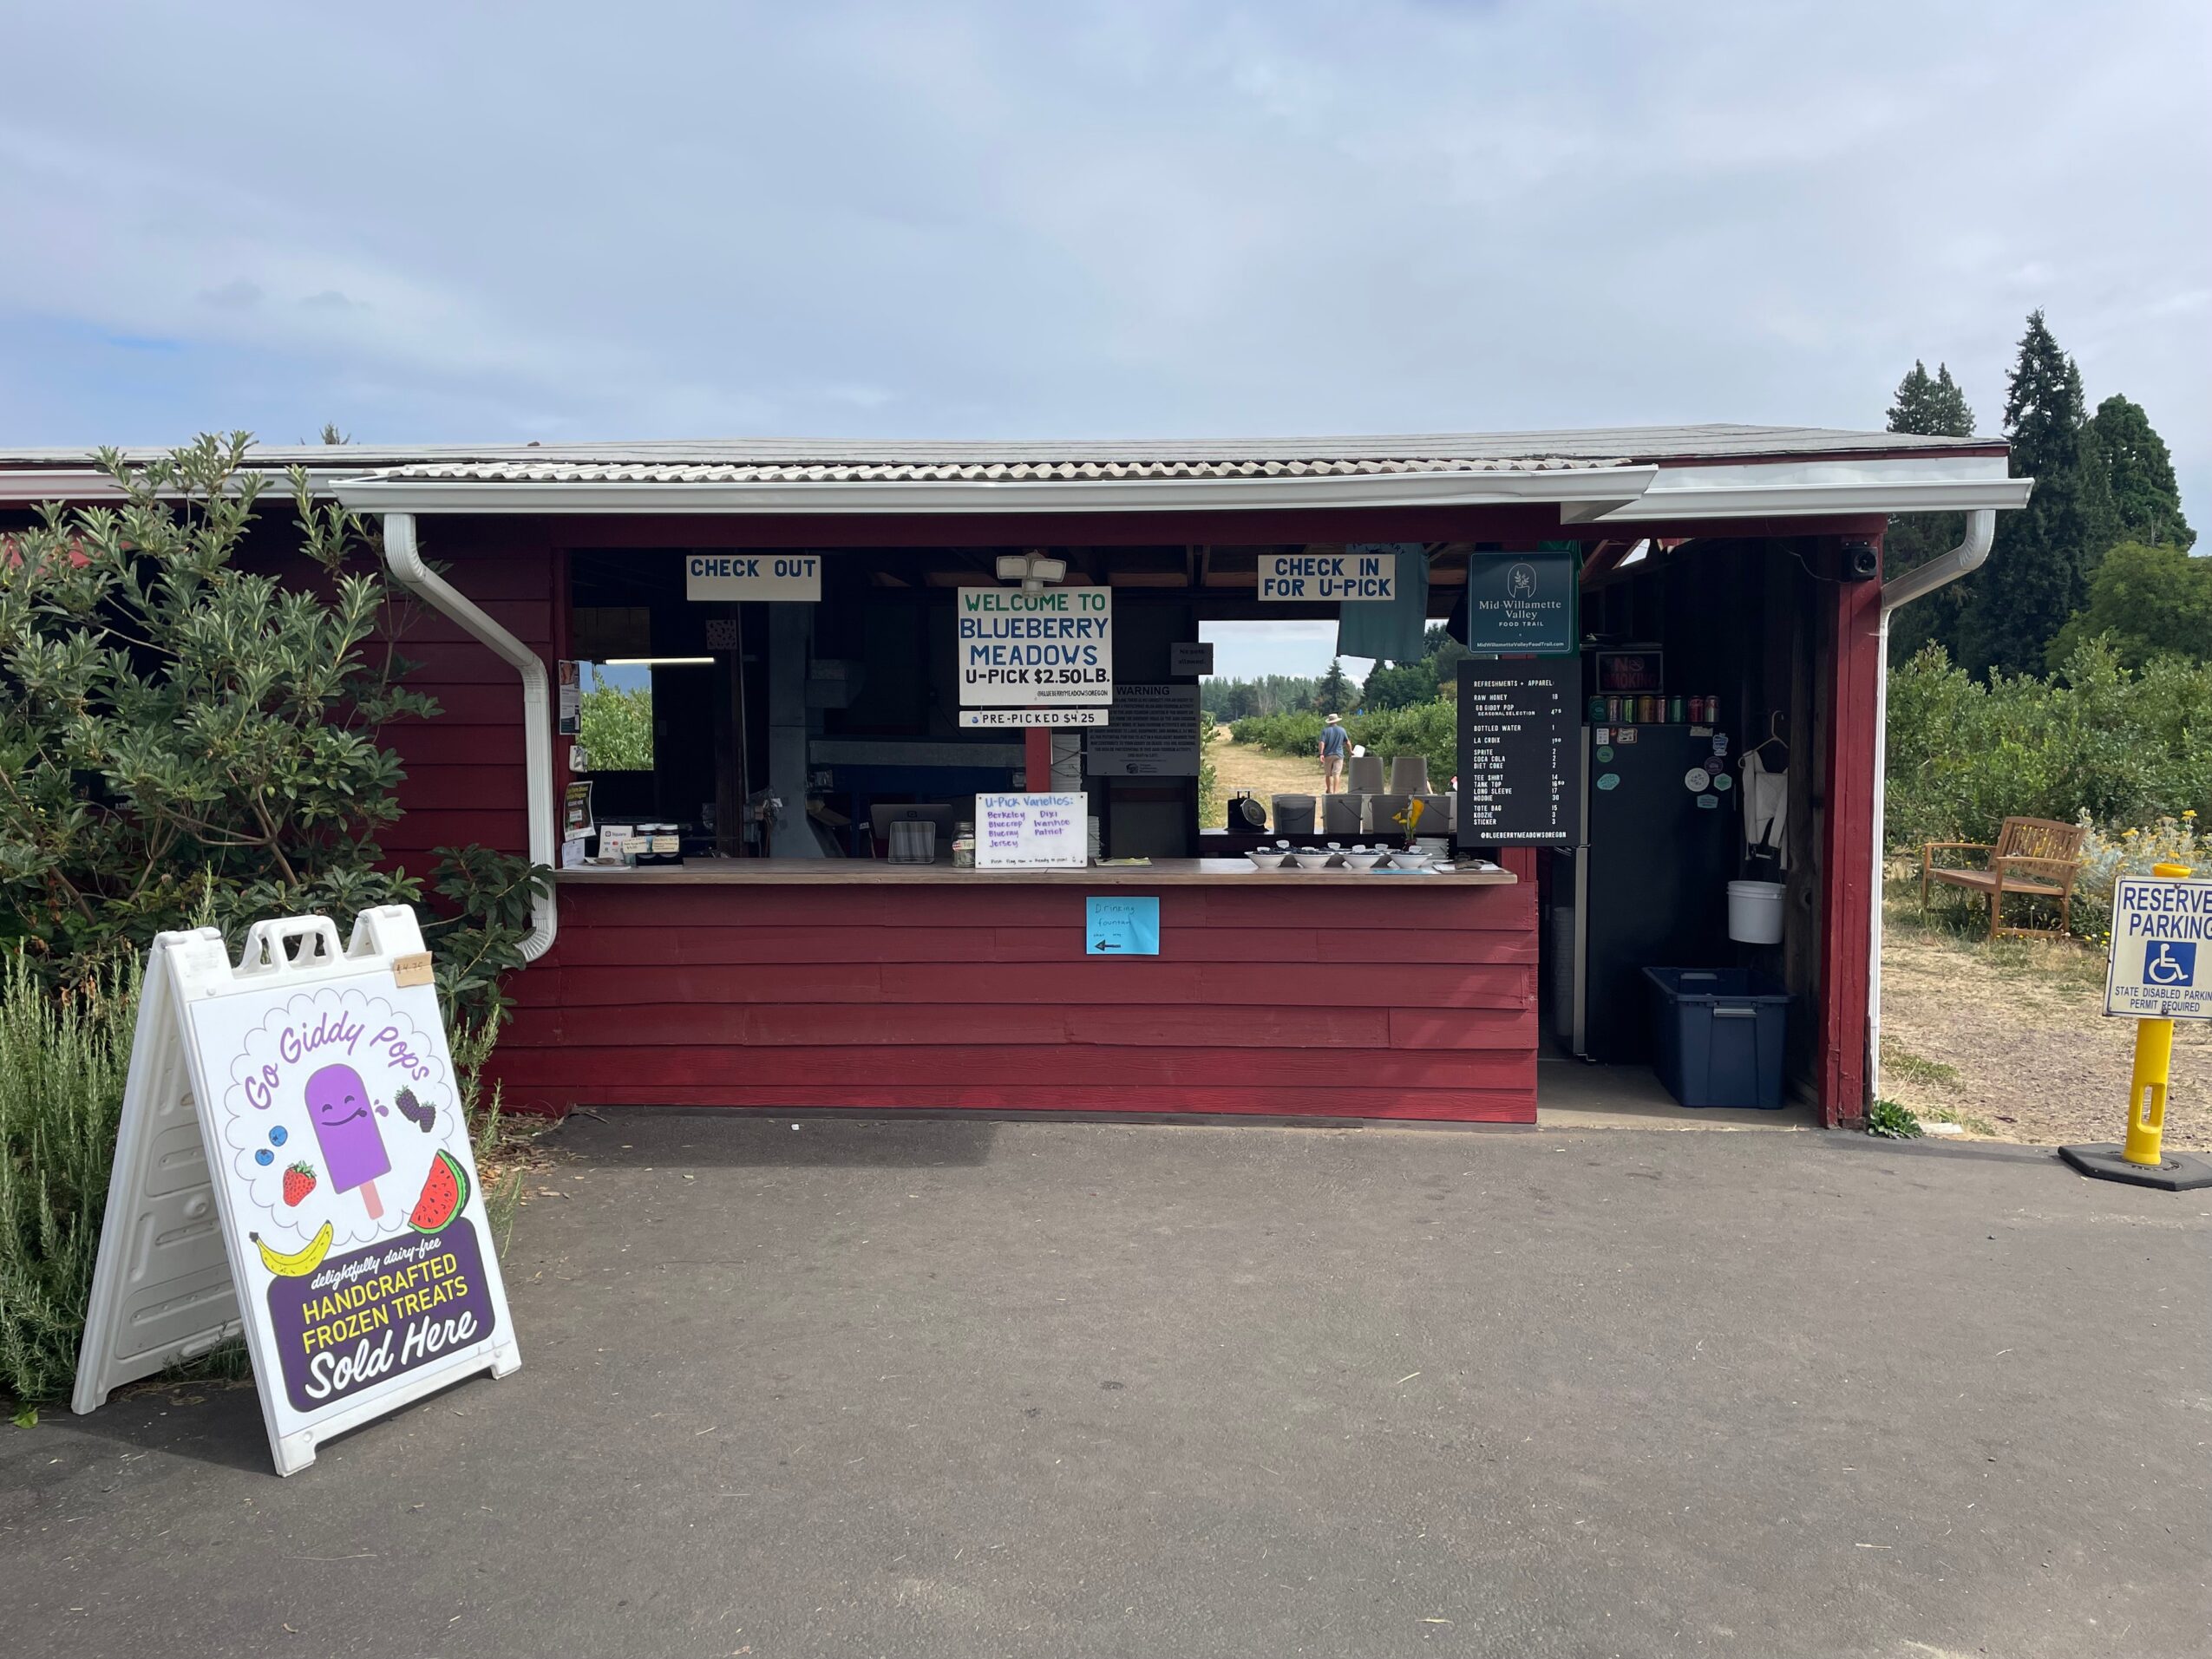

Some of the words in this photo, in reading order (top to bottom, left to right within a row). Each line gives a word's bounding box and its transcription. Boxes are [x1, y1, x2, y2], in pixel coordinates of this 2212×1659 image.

[690, 558, 759, 577] CHECK
[775, 559, 815, 578] OUT
[1275, 558, 1345, 576] CHECK
[1359, 558, 1379, 576] IN
[1264, 578, 1305, 596] FOR
[1319, 578, 1391, 597] U-PICK
[965, 593, 1069, 611] WELCOME
[1078, 593, 1105, 611] TO
[1479, 600, 1561, 610] Mid-Willamette
[1505, 610, 1538, 620] Valley
[960, 617, 1109, 638] BLUEBERRY
[970, 644, 1097, 665] MEADOWS
[965, 669, 1030, 684] U-PICK
[1116, 686, 1169, 696] WARNING
[982, 714, 1059, 723] PRE-PICKED
[1063, 714, 1095, 723] $4.25
[985, 796, 1020, 808] U-Pick
[987, 811, 1025, 820] Berkeley
[1039, 810, 1057, 819] Dixi
[988, 820, 1023, 829] Bluecrop
[988, 829, 1019, 839] Blueray
[989, 839, 1018, 848] Jersey
[2123, 886, 2212, 914] RESERVE
[2129, 913, 2212, 940] PARKING
[2115, 986, 2139, 997] STATE
[2143, 987, 2181, 999] DISABLED
[2184, 990, 2212, 1002] PARKIN
[2130, 998, 2158, 1009] PERMIT
[2161, 1001, 2200, 1013] REQUIRED
[245, 1062, 279, 1110] Go
[280, 1010, 365, 1064] Giddy
[370, 1026, 430, 1081] Pops
[311, 1255, 382, 1290] delightfully
[383, 1238, 442, 1265] dairy-free
[302, 1253, 457, 1325] HANDCRAFTED
[302, 1303, 389, 1355] FROZEN
[391, 1276, 468, 1319] TREATS
[304, 1329, 395, 1399] Sold
[400, 1310, 477, 1365] Here
